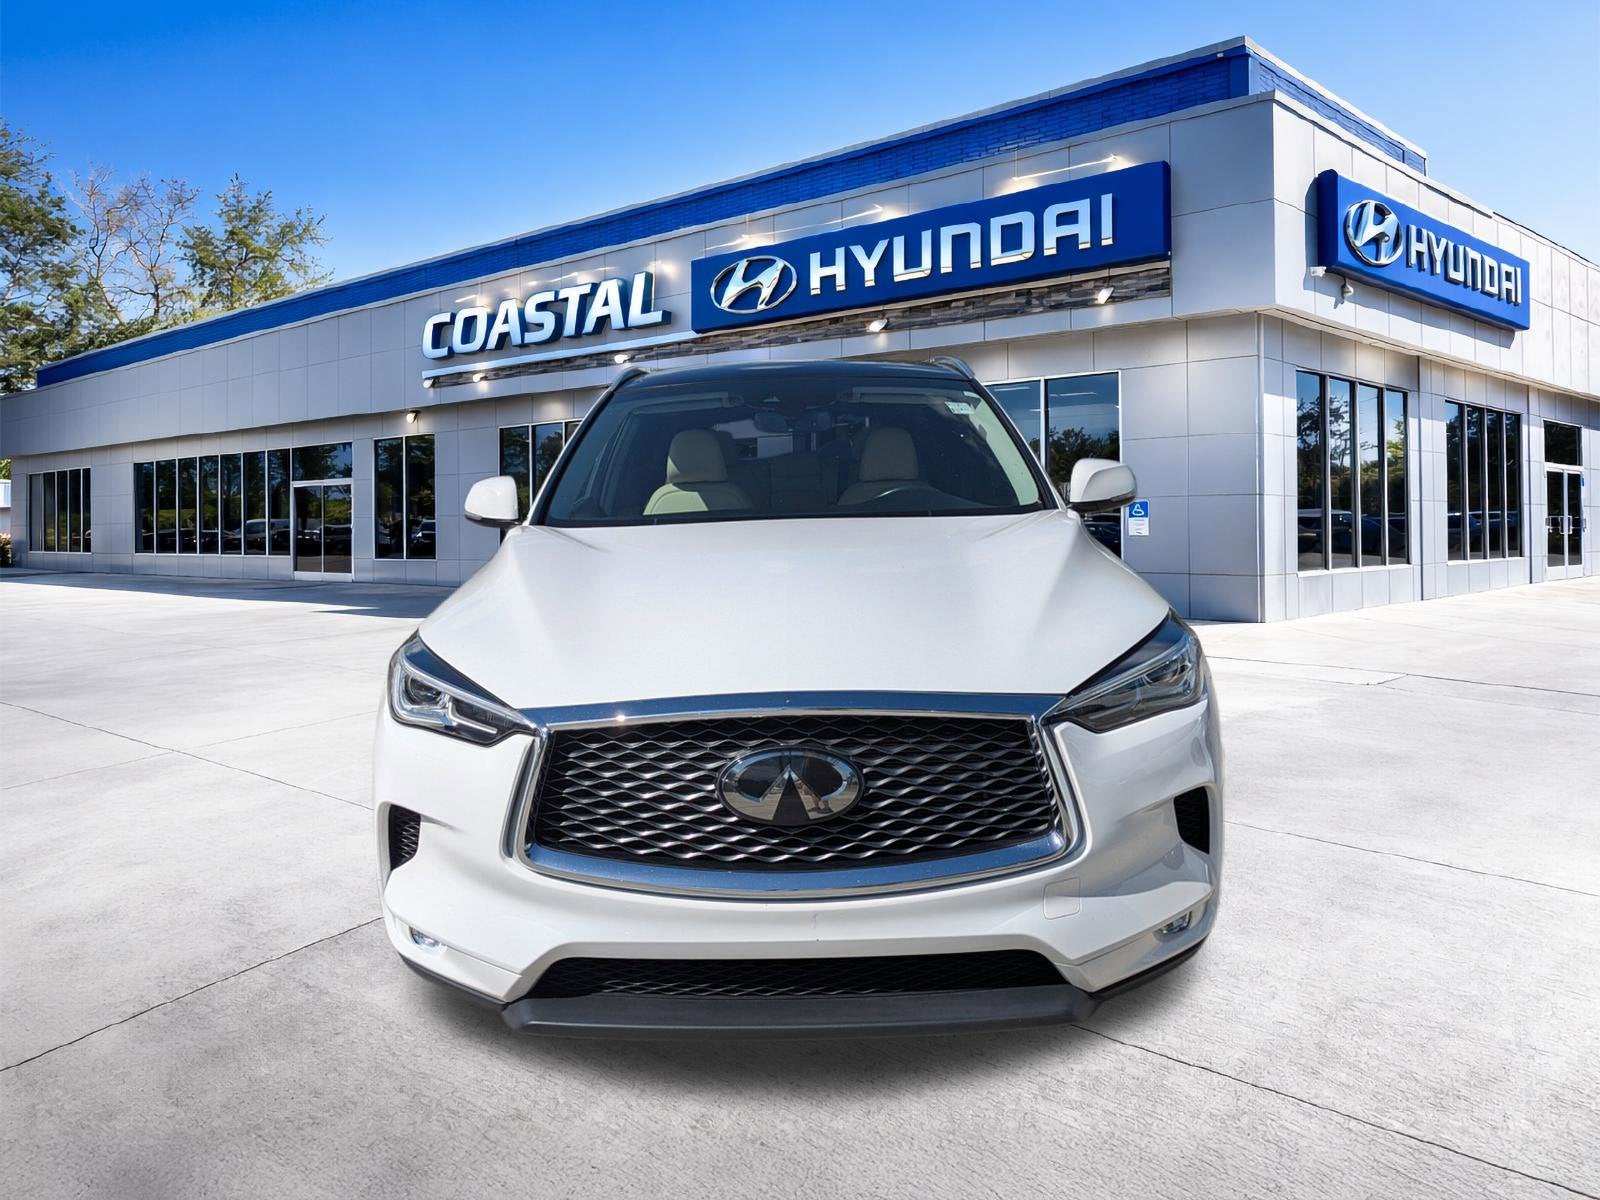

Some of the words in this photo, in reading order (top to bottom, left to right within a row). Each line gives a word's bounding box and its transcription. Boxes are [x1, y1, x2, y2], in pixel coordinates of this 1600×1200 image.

[810, 193, 1114, 295] HYUNDAI
[1408, 224, 1521, 305] HYUNDAI
[422, 271, 666, 359] COASTAL
